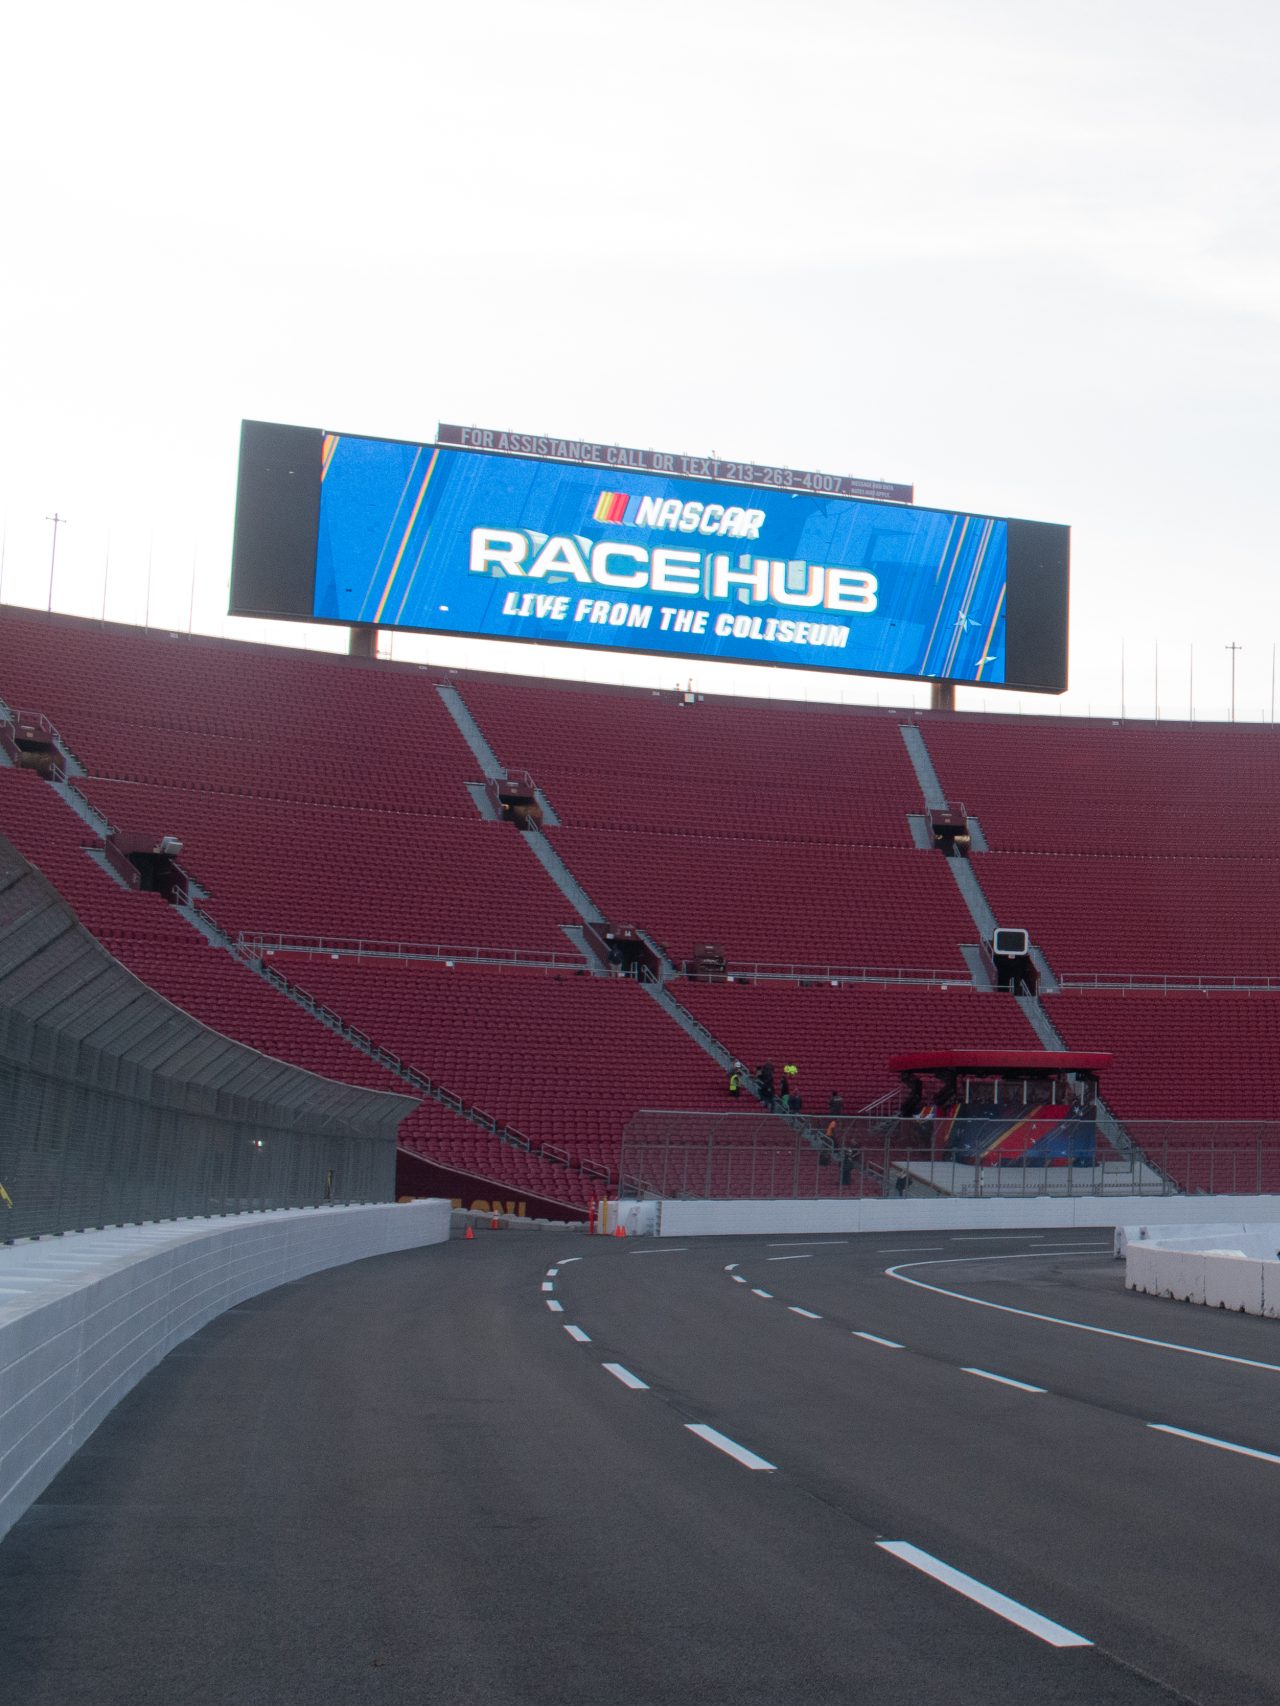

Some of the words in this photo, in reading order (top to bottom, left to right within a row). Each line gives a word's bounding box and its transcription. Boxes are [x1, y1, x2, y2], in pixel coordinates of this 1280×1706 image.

[461, 428, 493, 448] FOR
[499, 431, 601, 461] ASSISTANCE
[606, 447, 647, 467] CALL
[652, 453, 674, 471] OR
[680, 457, 721, 477] TEXT
[635, 495, 766, 540] NASCAR
[469, 527, 702, 594] RACE
[713, 554, 878, 613] HUB
[502, 591, 571, 621] LIVE
[574, 599, 653, 629] FROM
[659, 606, 710, 634] THE
[714, 612, 850, 648] COLISEUM
